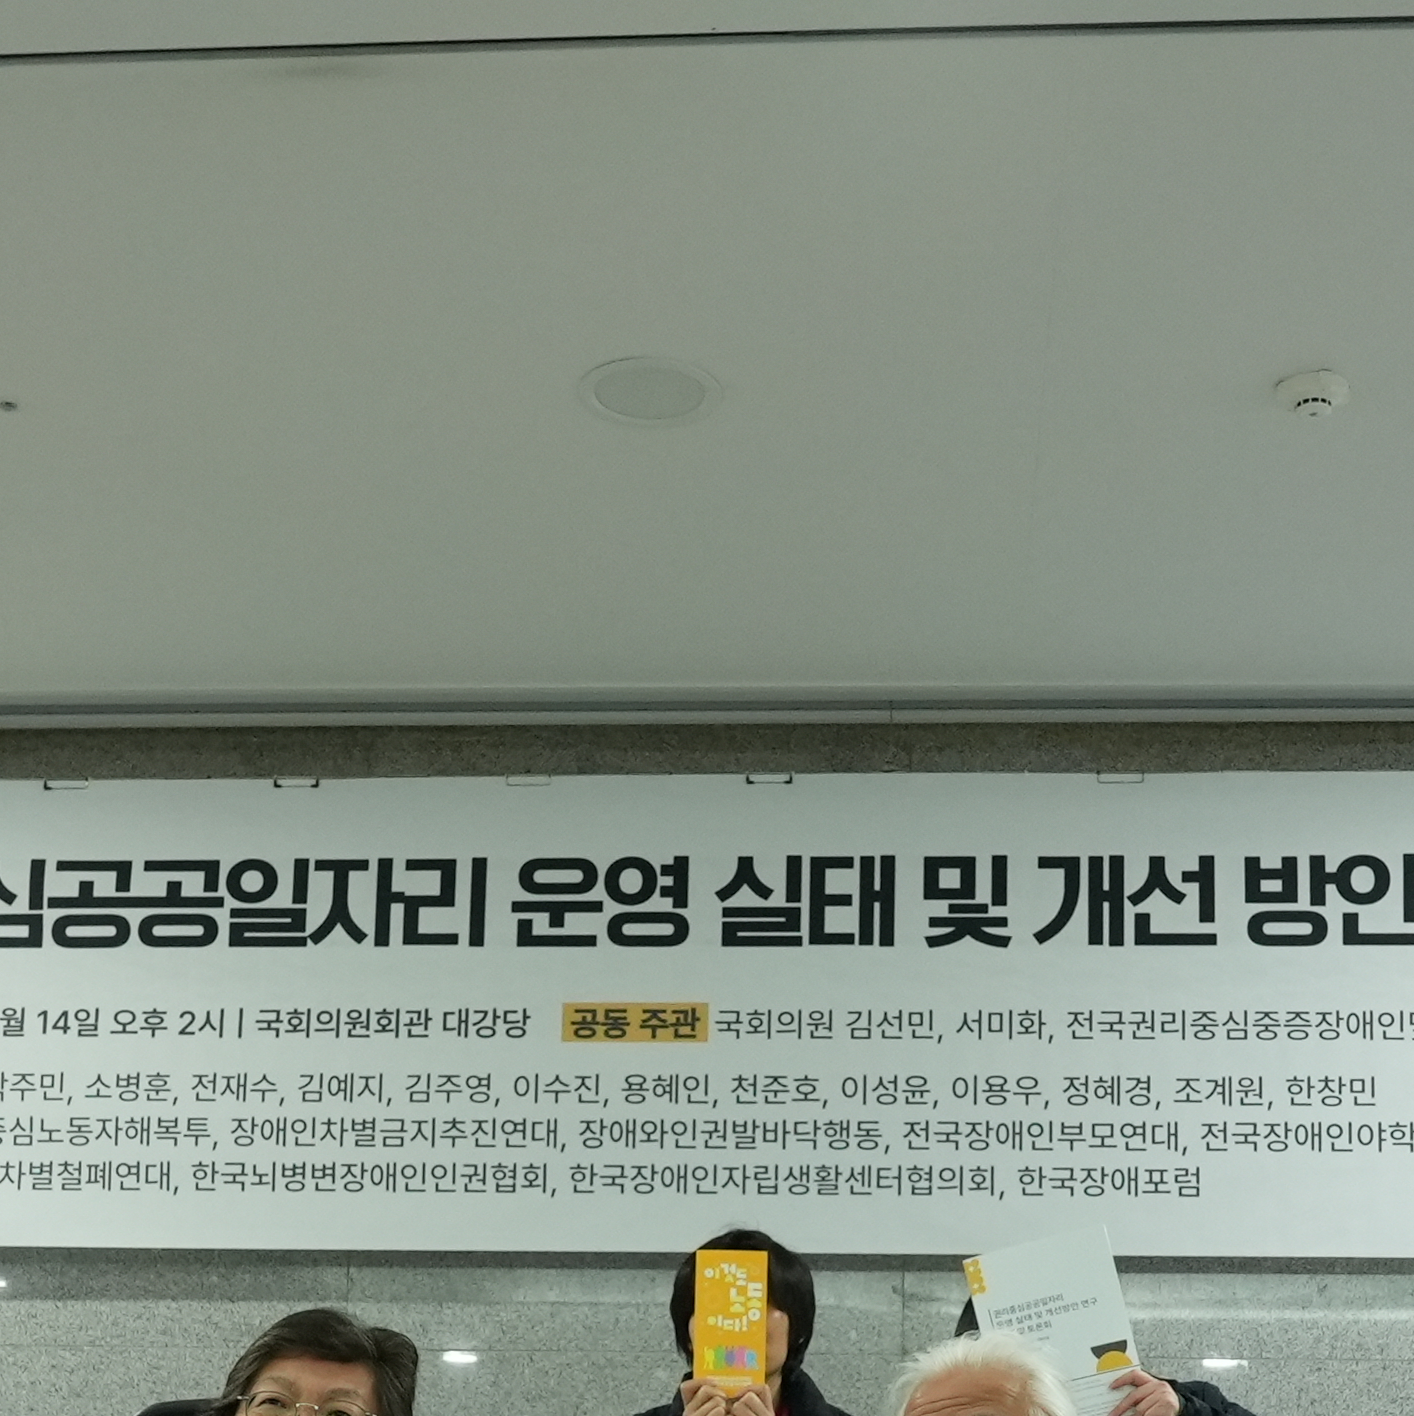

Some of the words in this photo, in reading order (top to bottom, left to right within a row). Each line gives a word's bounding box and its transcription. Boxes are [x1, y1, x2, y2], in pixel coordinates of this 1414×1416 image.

[511, 855, 690, 949] 운영
[714, 855, 896, 949] 실태
[921, 855, 1013, 949] 및
[1032, 855, 1218, 949] 개선
[37, 1007, 100, 1039] 14일
[110, 1007, 168, 1039] 오후
[178, 1007, 225, 1039] 2시
[254, 1007, 432, 1039] 국회의원회관
[442, 1007, 531, 1039] 대강당
[570, 1008, 630, 1040] 공동
[640, 1008, 700, 1040] 주관
[714, 1009, 834, 1041] 국회의원
[845, 1009, 944, 1044] 김선민,
[956, 1009, 1055, 1045] 서미화,
[84, 1072, 180, 1106] 소병훈,
[191, 1072, 286, 1106] 전재수,
[297, 1072, 393, 1106] 김예지,
[405, 1072, 501, 1106] 김주영,
[513, 1072, 610, 1106] 이수진,
[621, 1072, 719, 1106] 용혜인,
[730, 1073, 830, 1109] 천준호,
[841, 1075, 940, 1109] 이성윤,
[951, 1075, 1051, 1110] 이용우,
[1062, 1075, 1162, 1110] 정혜경,
[1174, 1075, 1275, 1111] 조계원,
[1286, 1075, 1378, 1108] 한창민
[229, 1116, 568, 1153] 장애인차별금지추진연대,
[578, 1117, 891, 1155] 장애와인권발바닥행동,
[902, 1120, 1189, 1155] 전국장애인부모연대,
[191, 1161, 558, 1198] 한국뇌병변장애인인권협회,
[569, 1163, 1006, 1201] 한국장애인자립생활센터협의회,
[1017, 1165, 1203, 1198] 한국장애포럼
